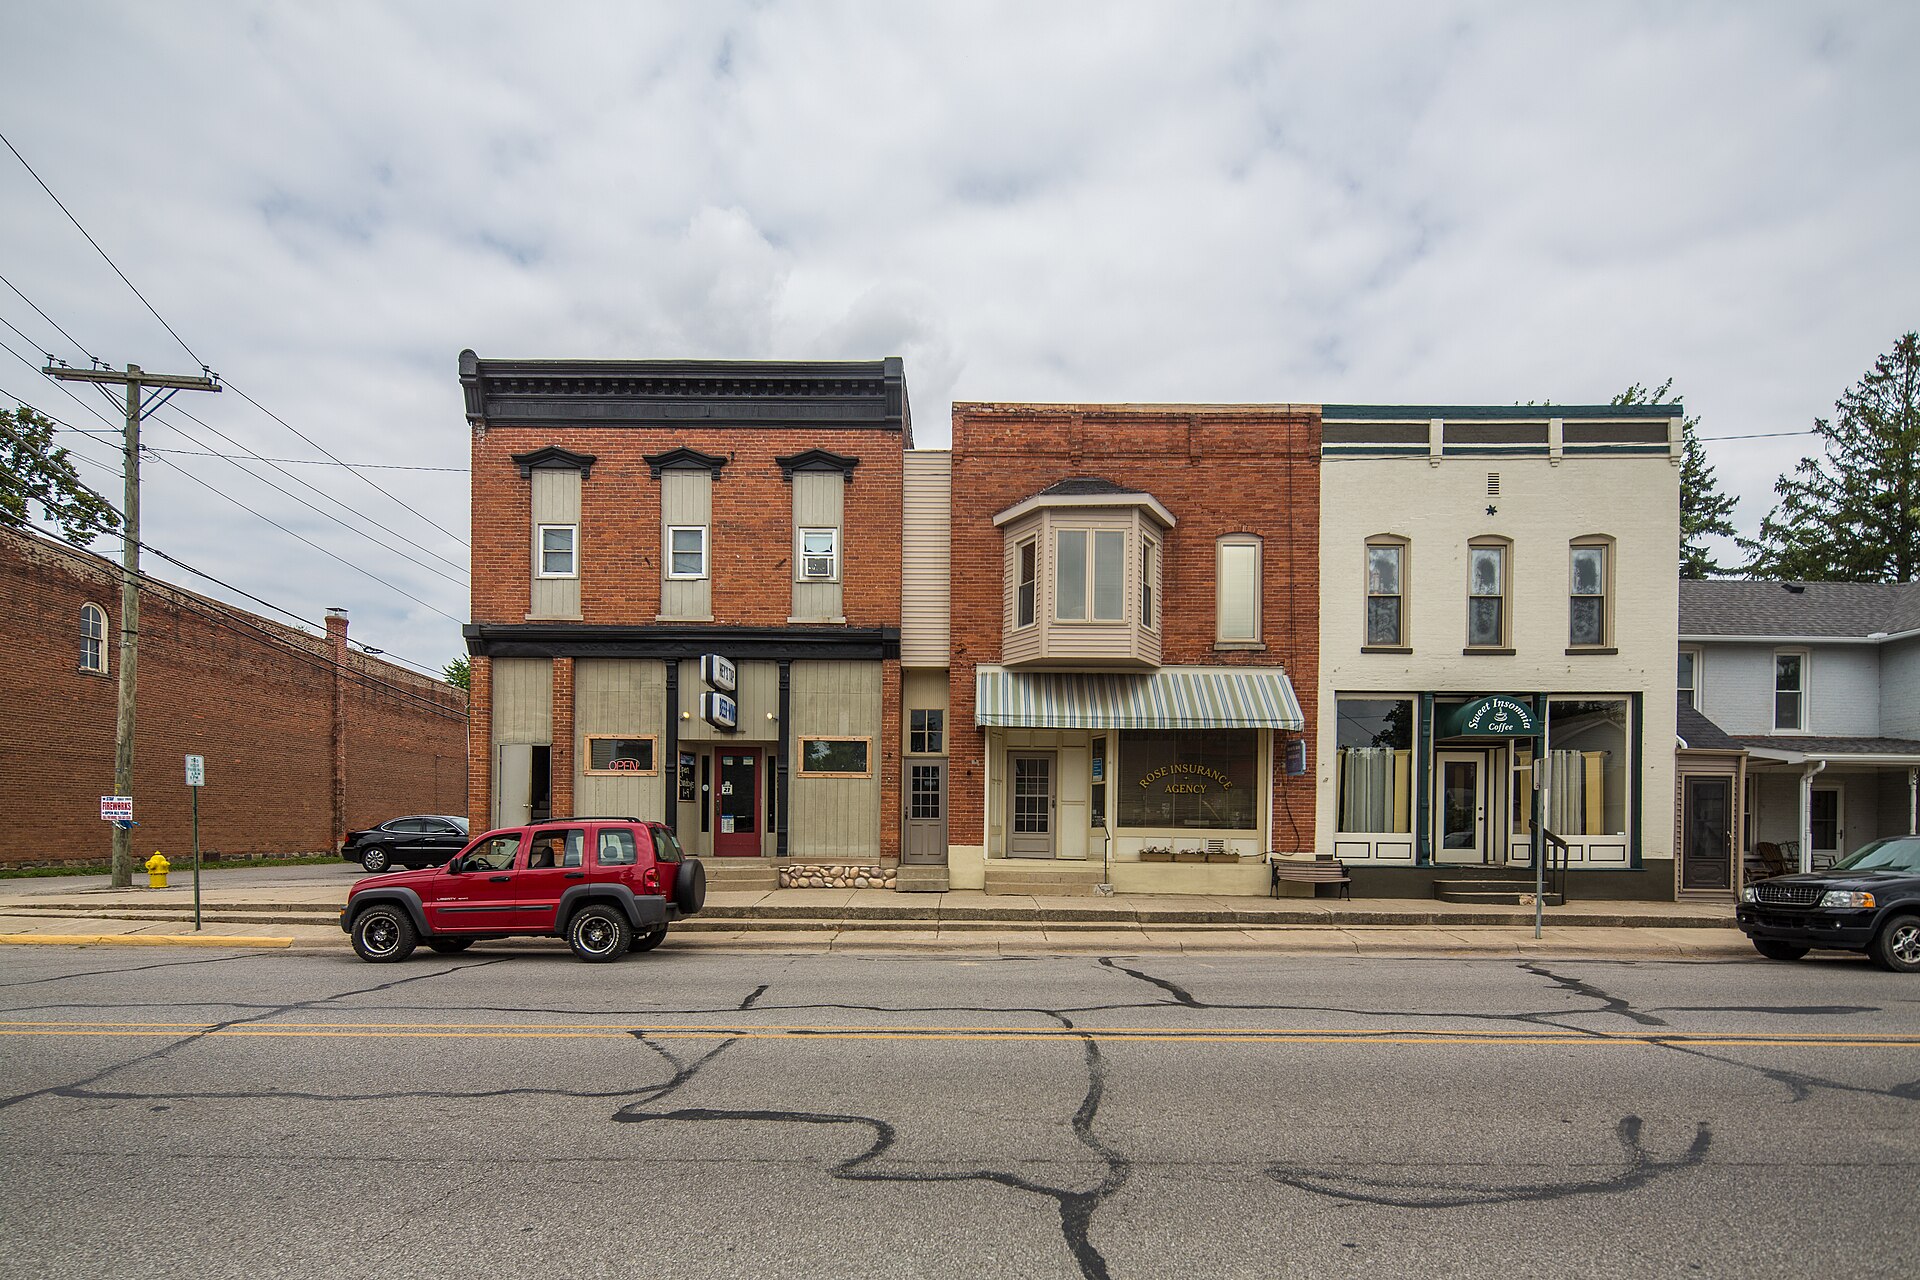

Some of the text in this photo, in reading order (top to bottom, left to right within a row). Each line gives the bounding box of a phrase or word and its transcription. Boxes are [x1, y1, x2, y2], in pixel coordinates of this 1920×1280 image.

[1468, 698, 1532, 729] Sweet Insomnia
[1488, 722, 1514, 733] Coffee
[608, 760, 638, 771] OPEN
[1139, 764, 1233, 790] ROSE INSURANCE
[1164, 784, 1207, 794] AGENCY
[102, 802, 132, 811] FIREWORKS
